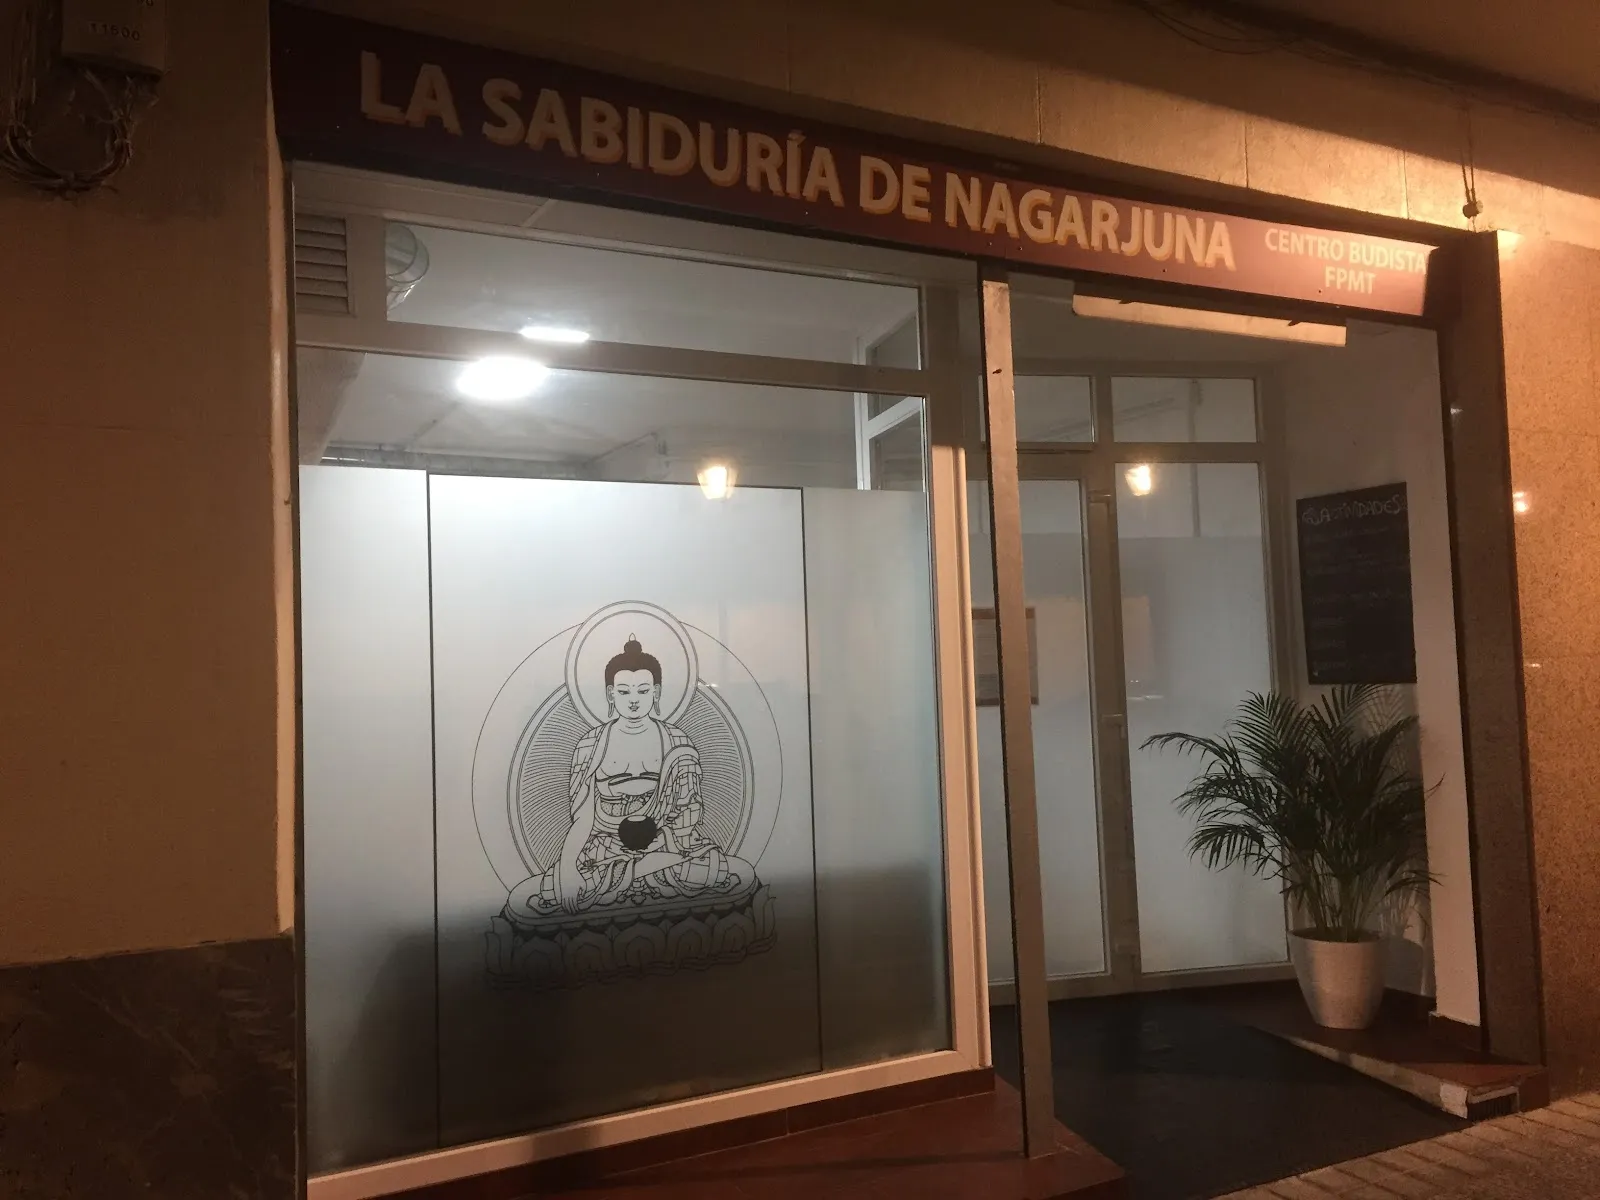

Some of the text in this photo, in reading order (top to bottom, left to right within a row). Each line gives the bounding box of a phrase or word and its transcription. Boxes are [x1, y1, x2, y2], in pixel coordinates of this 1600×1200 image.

[360, 50, 1237, 271] LA SABIDURÍA DE NAGARJUNA
[1264, 228, 1428, 273] CENTRO BUDISTA
[1325, 266, 1376, 295] FPMT
